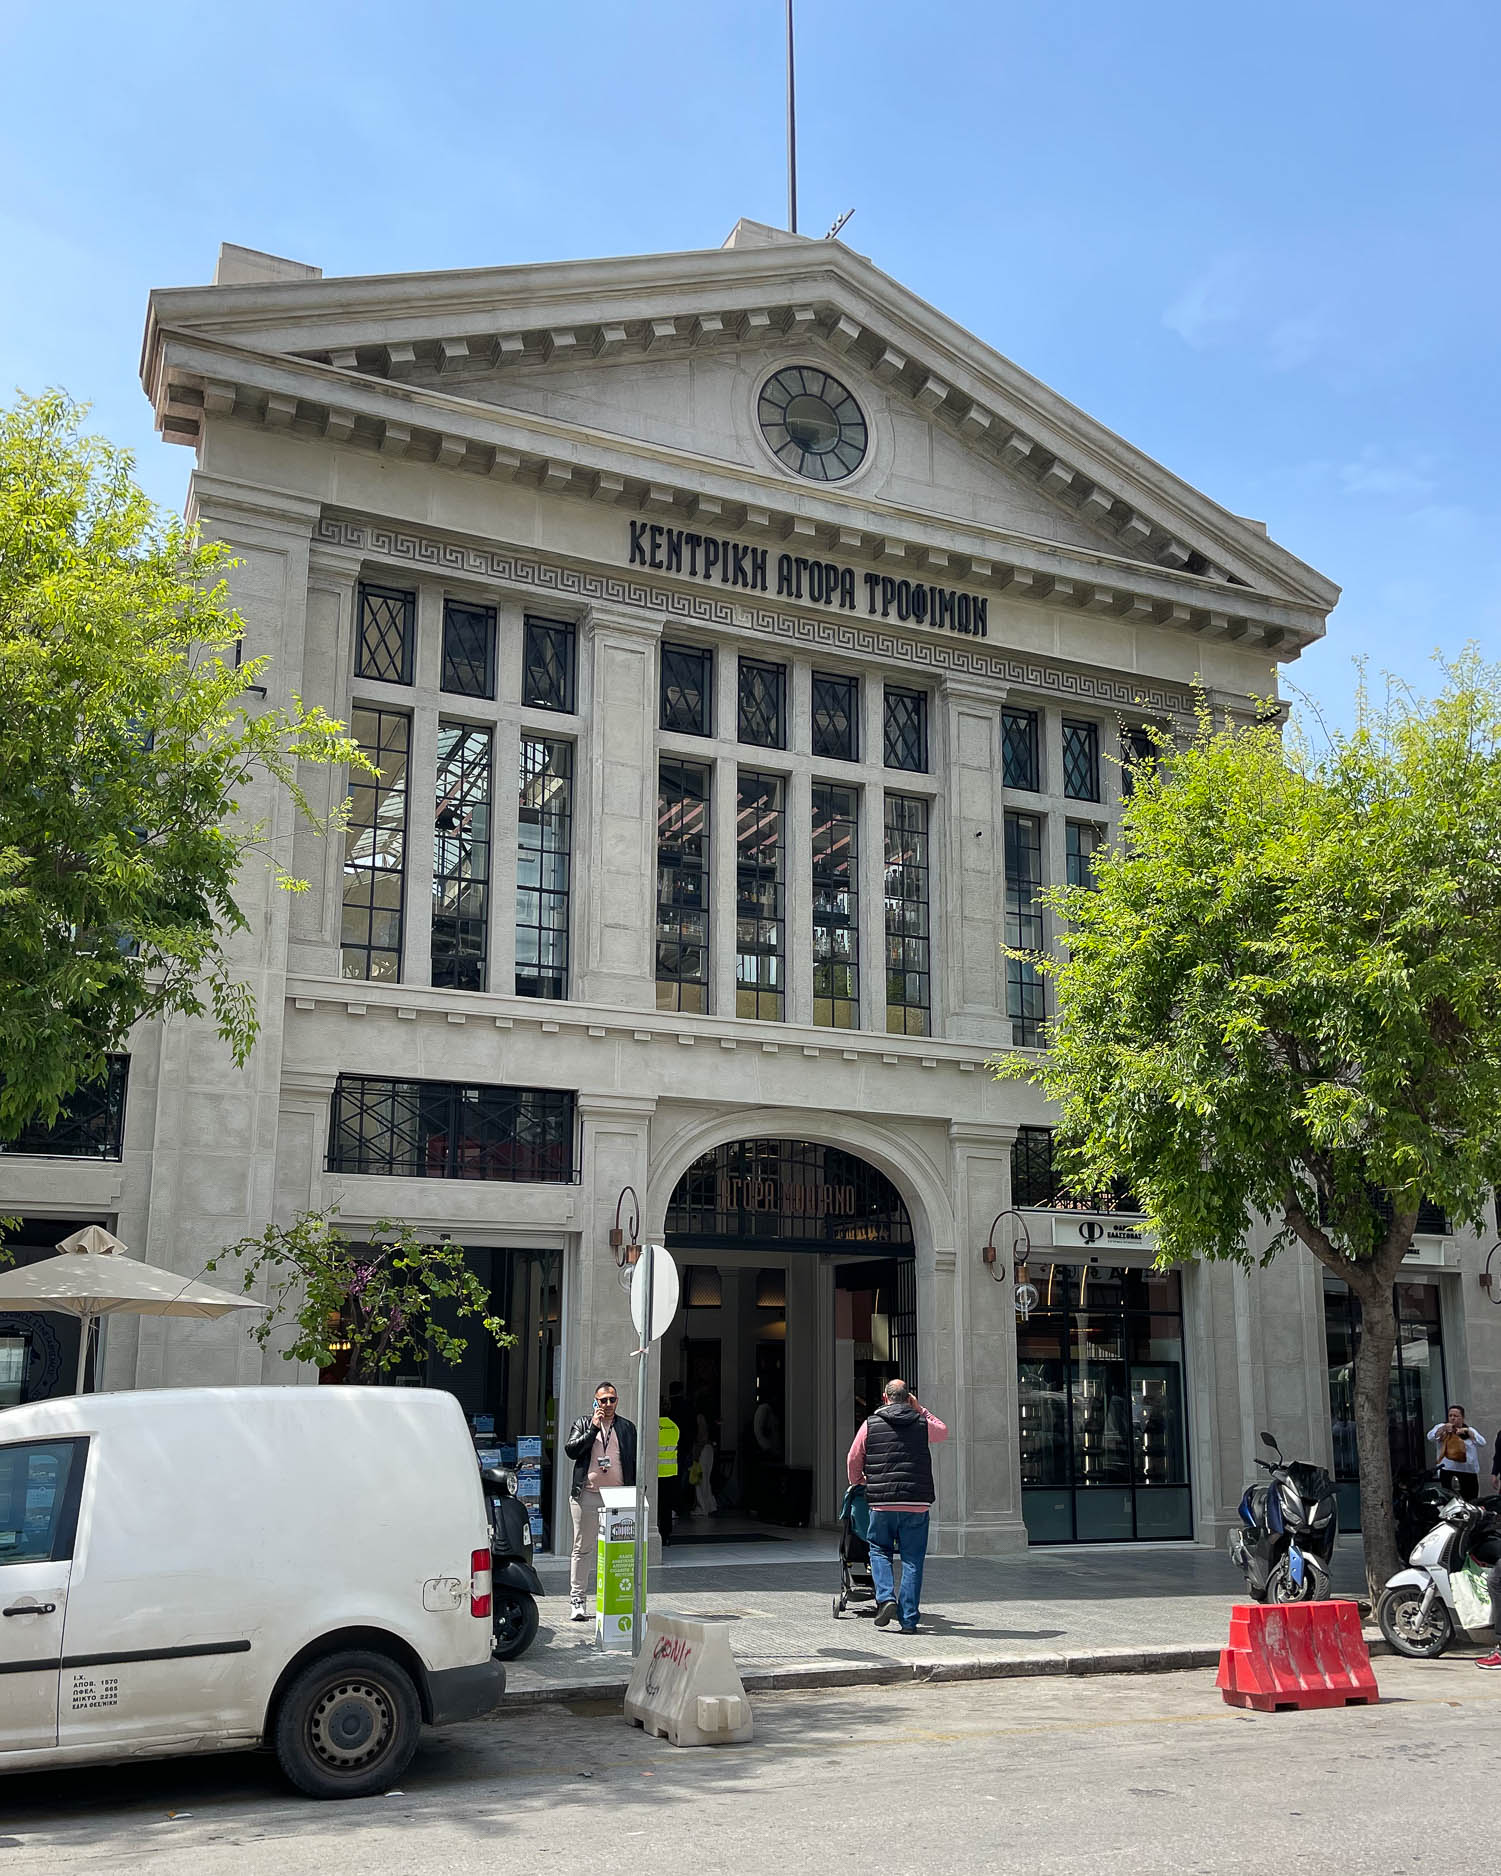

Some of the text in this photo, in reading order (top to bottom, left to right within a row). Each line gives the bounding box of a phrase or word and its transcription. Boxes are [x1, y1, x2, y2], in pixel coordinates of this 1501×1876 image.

[629, 520, 989, 637] ΚΕΝΤΡΙΚΗ ΑΓΟΡΑ ΤΡΟΦΙΜΩΝ
[101, 1678, 118, 1686] 1570
